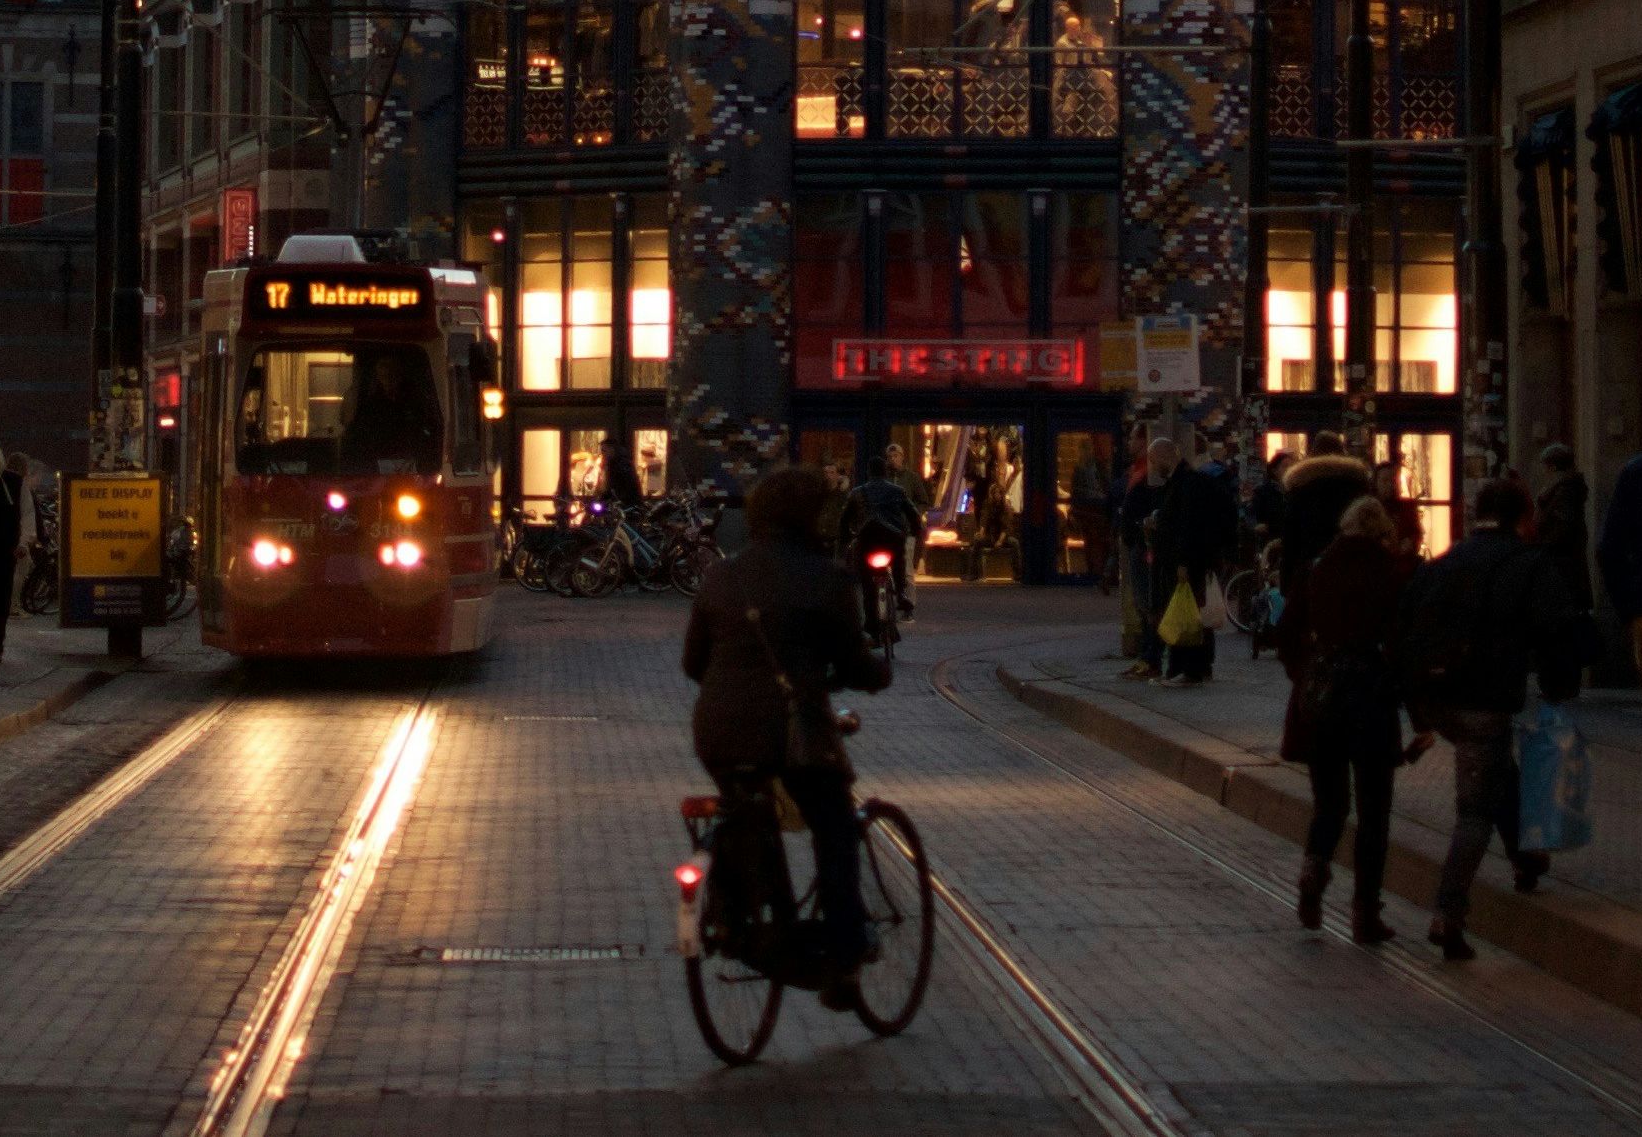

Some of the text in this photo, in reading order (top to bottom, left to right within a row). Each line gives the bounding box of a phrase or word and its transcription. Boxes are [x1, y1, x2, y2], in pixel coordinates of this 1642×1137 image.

[265, 281, 291, 309] 17
[846, 347, 1067, 374] THE STING
[79, 487, 154, 499] DEZE DISPLAY
